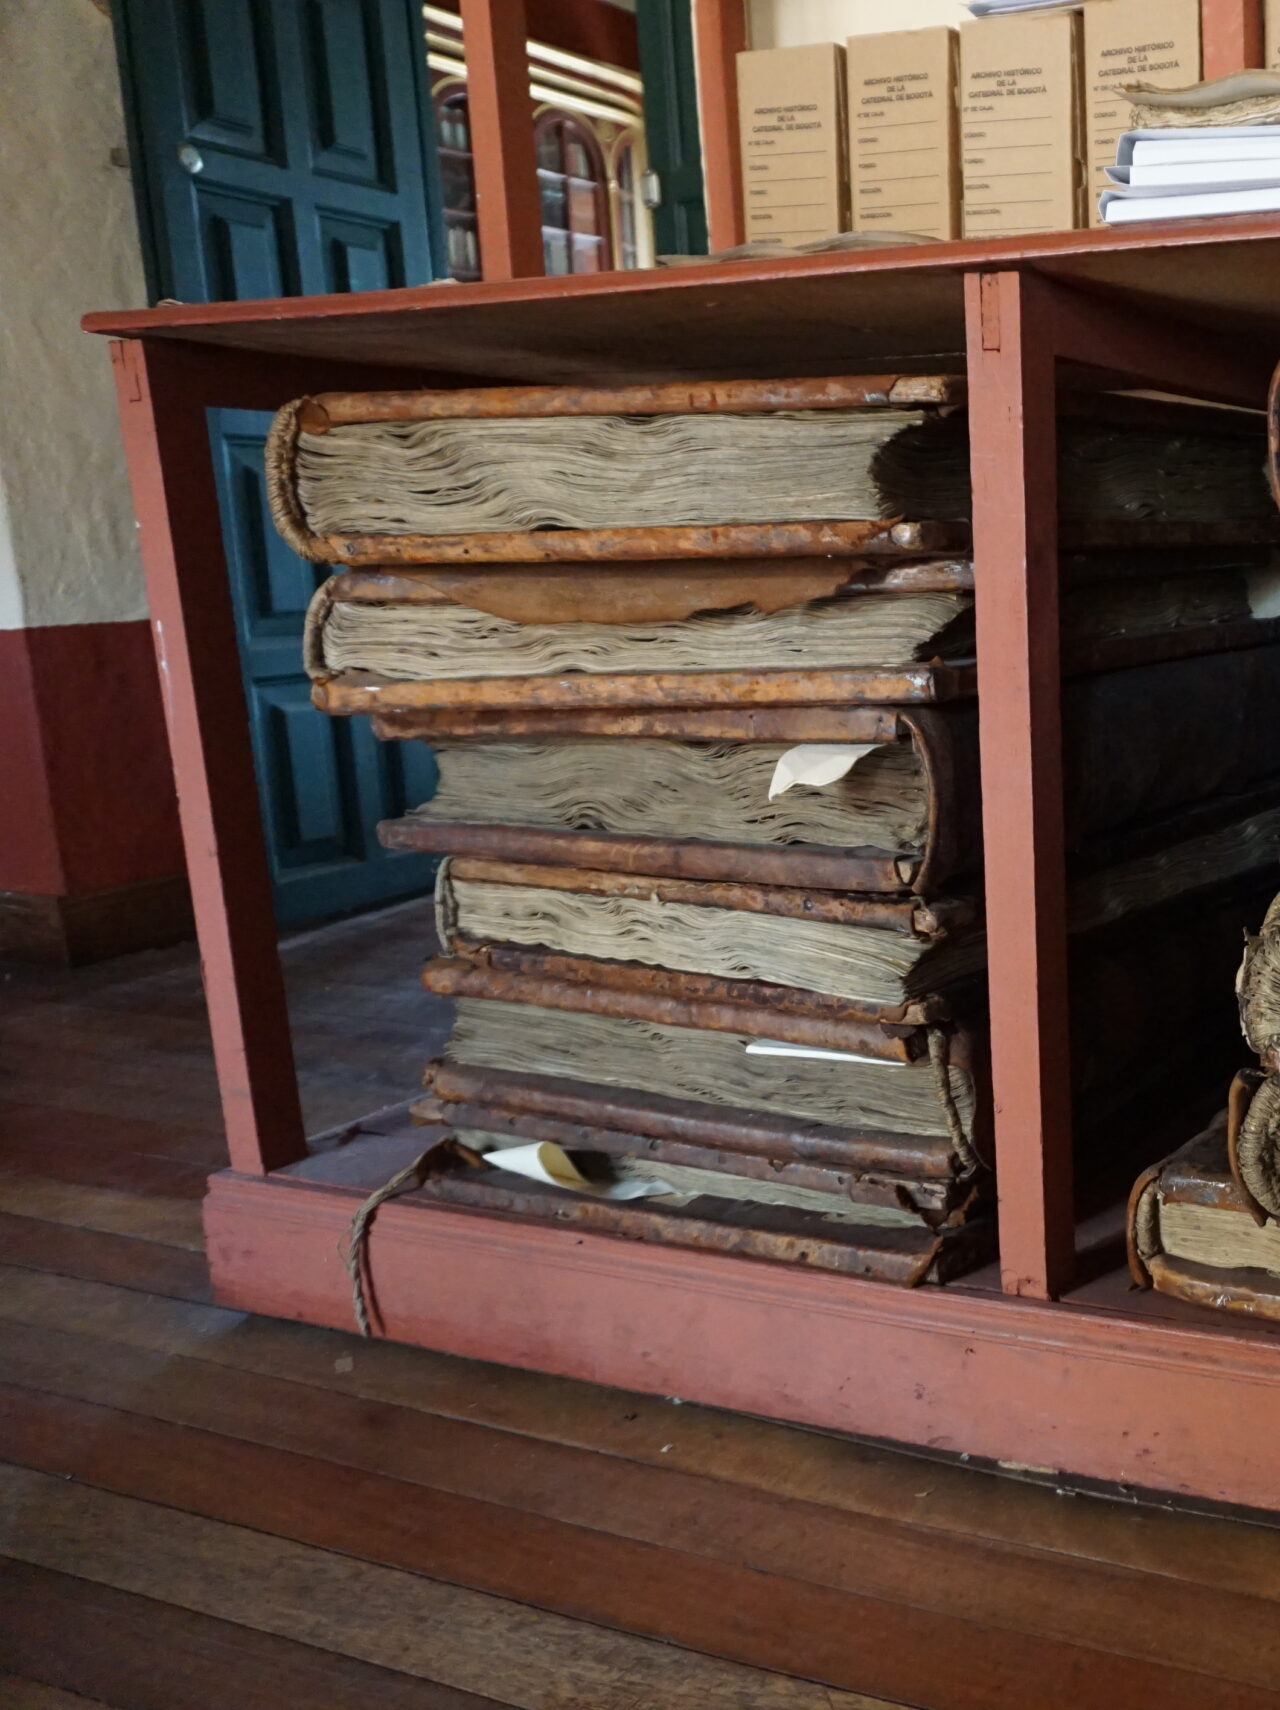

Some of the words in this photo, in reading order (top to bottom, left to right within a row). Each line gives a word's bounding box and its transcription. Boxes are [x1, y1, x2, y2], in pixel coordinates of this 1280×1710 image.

[1101, 46, 1133, 56] ARCHIVO
[1135, 41, 1175, 52] HISTÓRICO
[971, 70, 1001, 79] ARCHIVO
[1098, 66, 1136, 77] CATEDRAL
[1137, 64, 1147, 72] DE
[1149, 59, 1180, 71] BOGOTÁ
[968, 89, 1004, 98] CATEDRAL
[1017, 85, 1047, 94] BOGOTÁ
